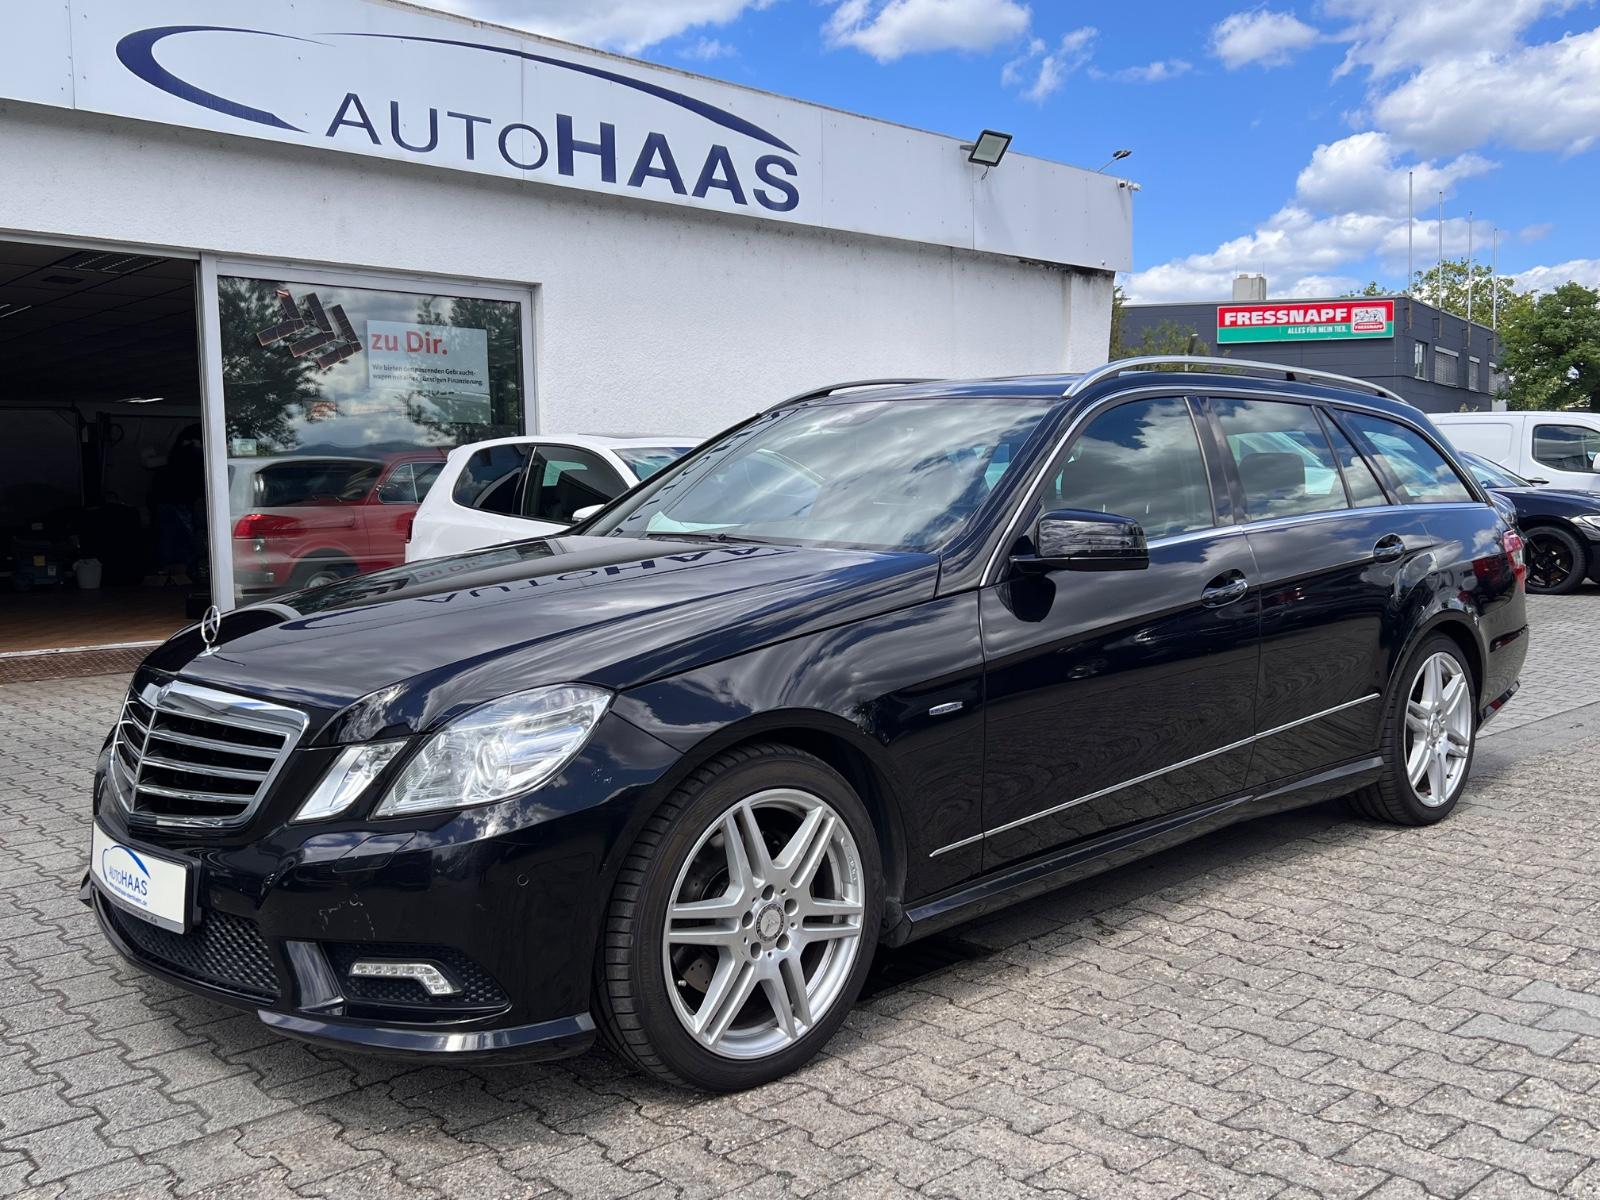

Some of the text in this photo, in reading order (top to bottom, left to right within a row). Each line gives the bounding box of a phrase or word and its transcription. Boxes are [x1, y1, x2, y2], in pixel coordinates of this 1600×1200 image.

[324, 92, 801, 212] AUTOHAAS
[1224, 308, 1347, 326] FRESSNAPF
[371, 330, 449, 355] zu Dir.
[1287, 327, 1306, 335] ALLES
[1306, 326, 1317, 334] FÜR
[1318, 326, 1333, 334] MEIN
[109, 865, 148, 896] AUTOHAAS
